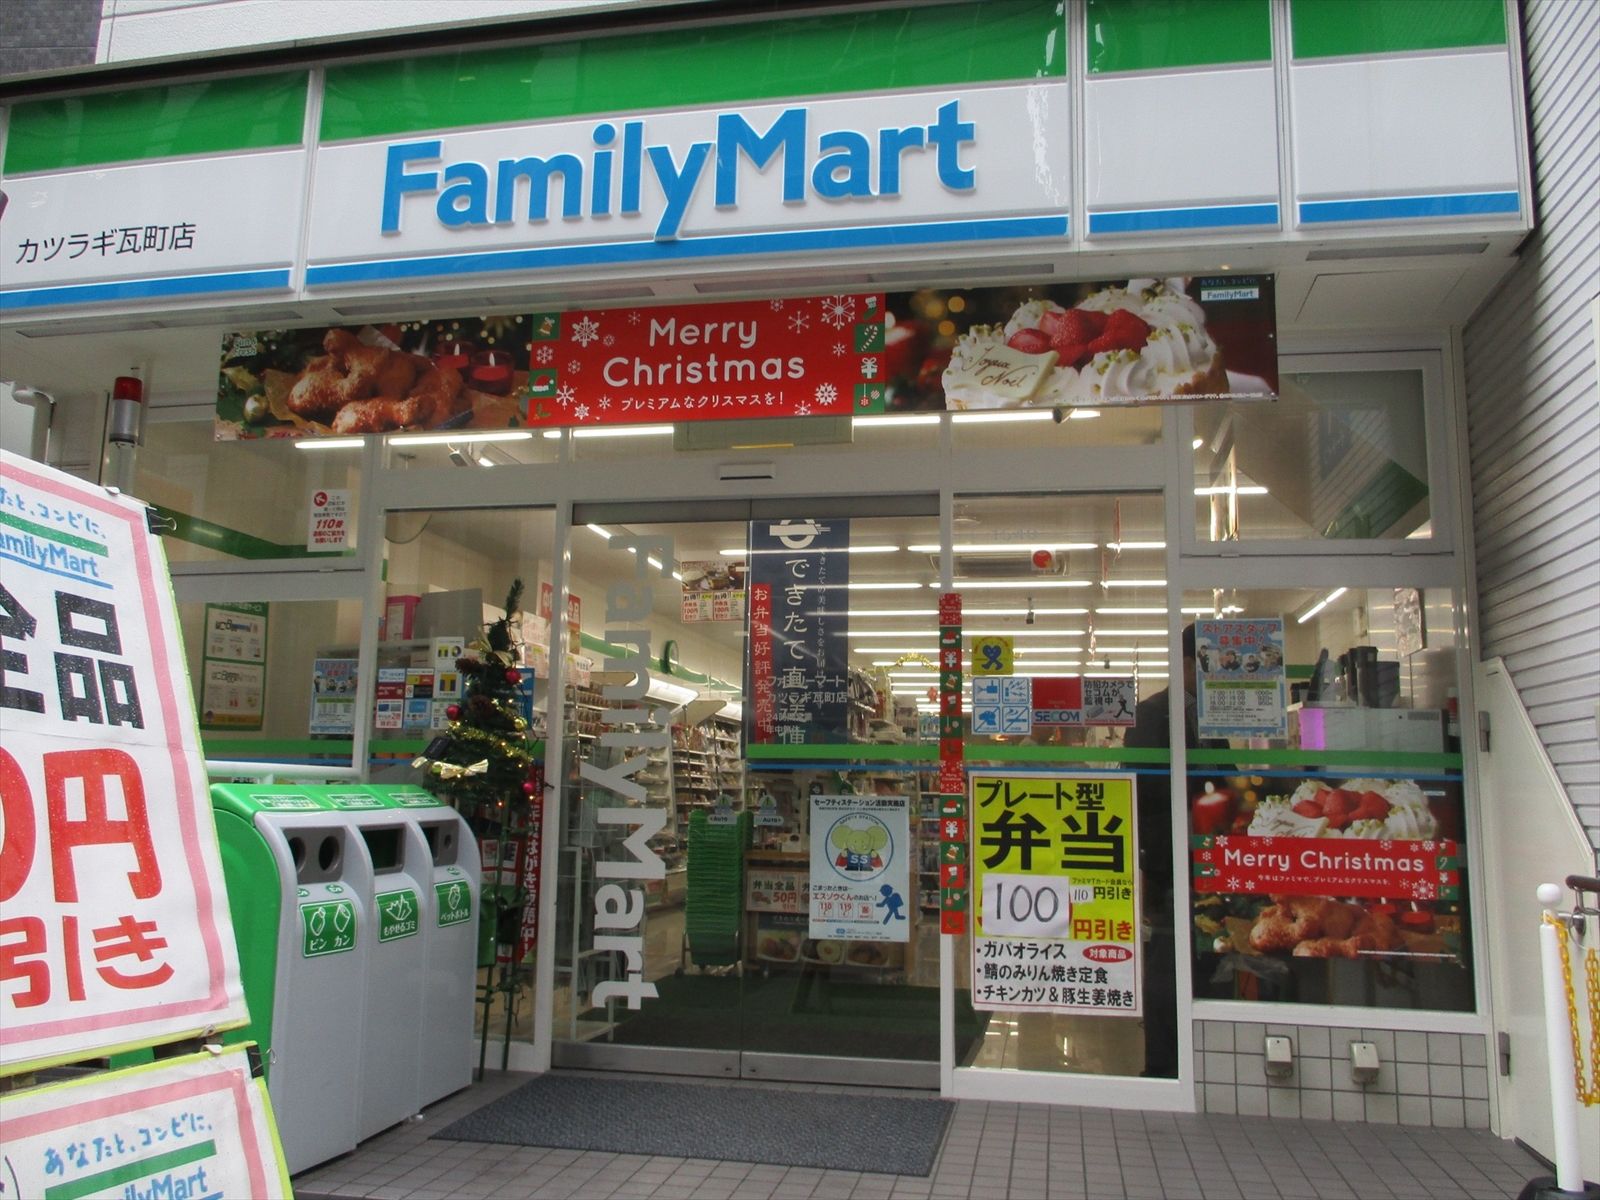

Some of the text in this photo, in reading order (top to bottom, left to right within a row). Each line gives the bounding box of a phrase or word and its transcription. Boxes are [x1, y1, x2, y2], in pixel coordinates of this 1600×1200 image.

[380, 100, 976, 242] FamilyMart
[15, 222, 197, 265] カツラギ瓦町店
[1207, 290, 1254, 299] FamilyMart
[649, 317, 758, 349] Merry
[603, 353, 805, 387] Christmas
[1034, 711, 1081, 722] SECOM
[579, 534, 675, 1011] FamilyMart
[976, 779, 1106, 811] プレート型
[980, 810, 1125, 873] 弁当
[850, 854, 869, 864] SS
[1223, 848, 1425, 876] Merry Christmas
[996, 882, 1060, 923] 100
[333, 934, 351, 948] カン
[1073, 919, 1132, 941] 円引き
[0, 914, 175, 1009] 引き
[1087, 947, 1128, 960] 対象商品
